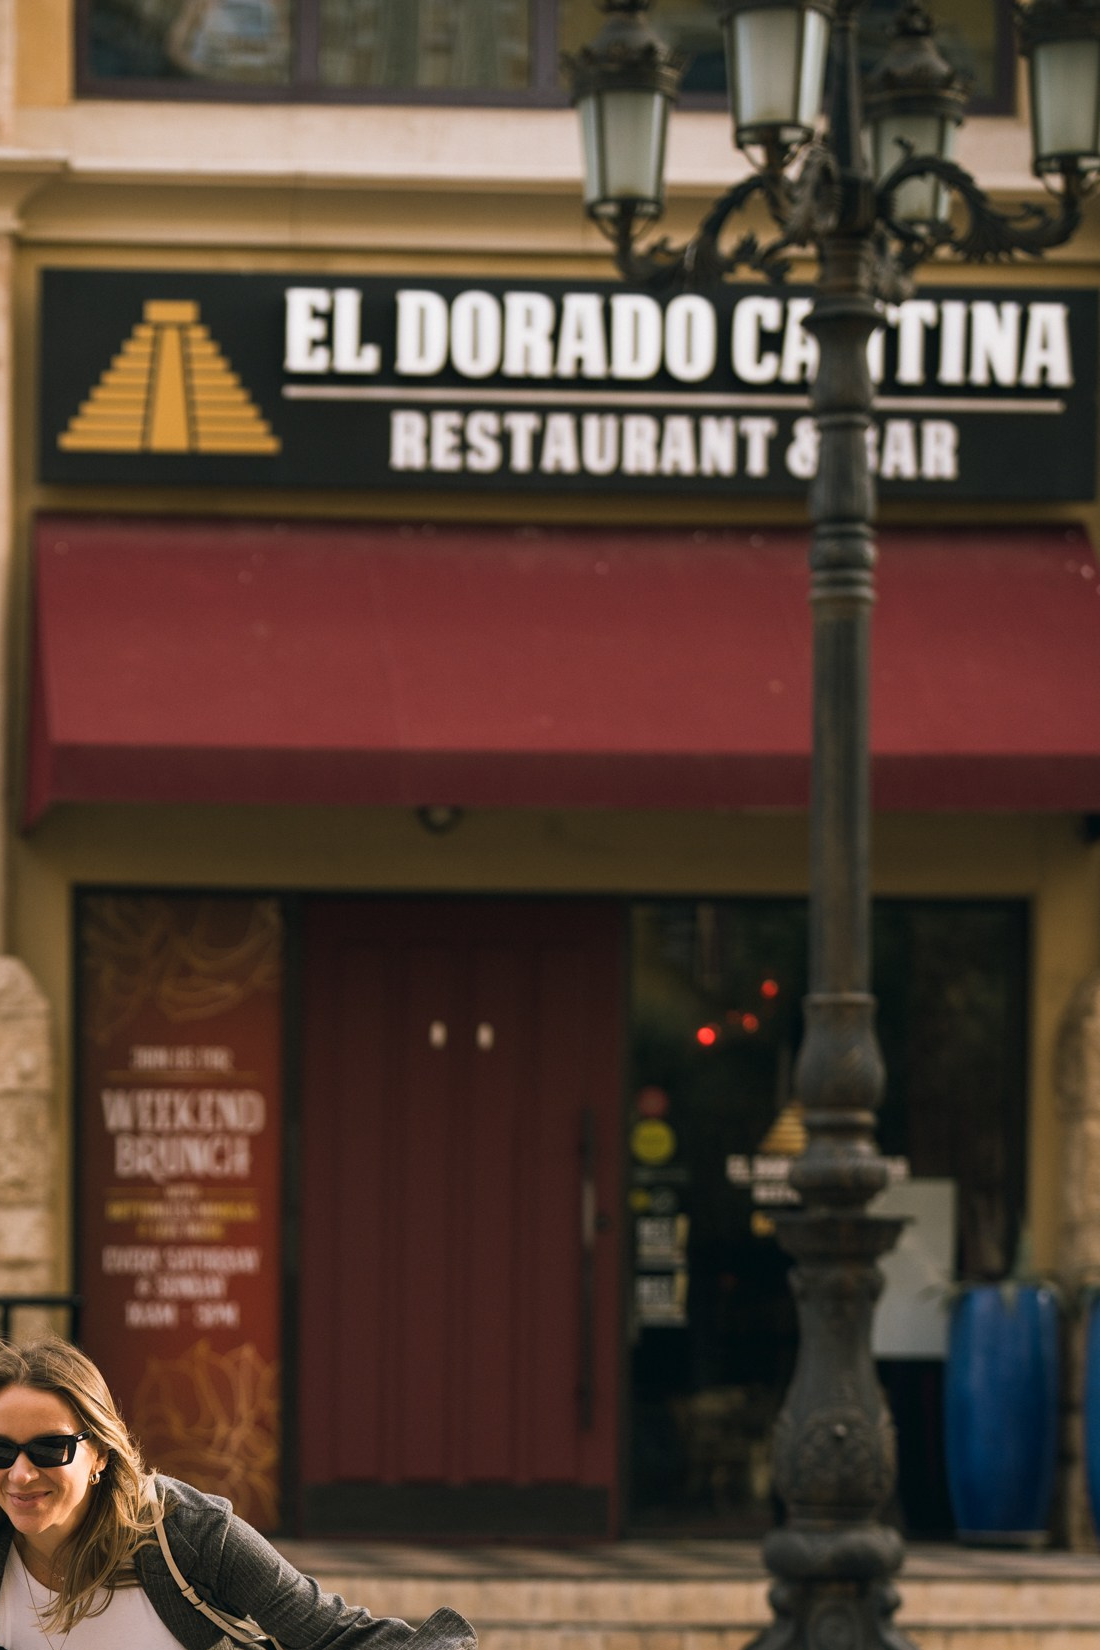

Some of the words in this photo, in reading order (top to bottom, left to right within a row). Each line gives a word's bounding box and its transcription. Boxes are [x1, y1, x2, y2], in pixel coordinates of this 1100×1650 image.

[284, 287, 380, 374] EL
[395, 289, 717, 382] DORADO
[390, 410, 777, 477] RESTAURANT
[102, 1088, 266, 1135] WEEKEND
[114, 1133, 251, 1183] BRUNCH
